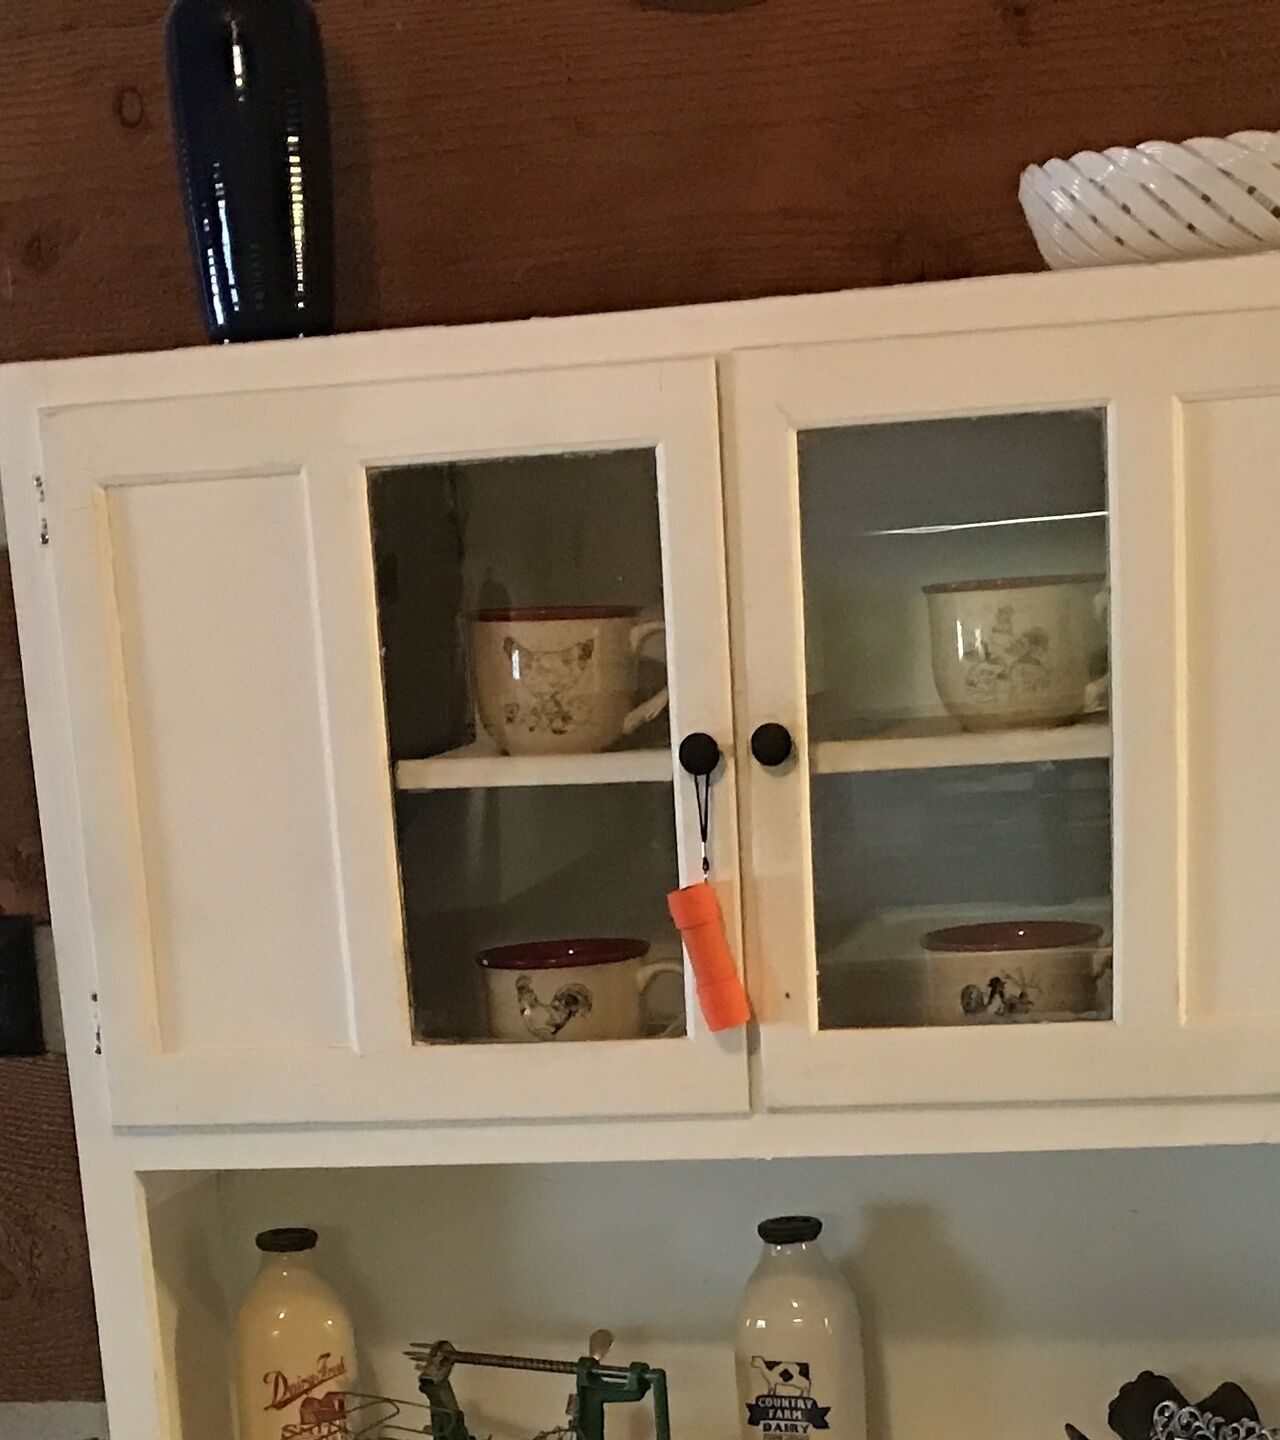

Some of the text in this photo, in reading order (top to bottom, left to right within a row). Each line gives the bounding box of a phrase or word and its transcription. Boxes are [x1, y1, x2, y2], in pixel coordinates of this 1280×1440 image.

[758, 1397, 814, 1409] COUNTRY
[768, 1409, 802, 1420] FARM
[763, 1422, 810, 1434] DAIRY
